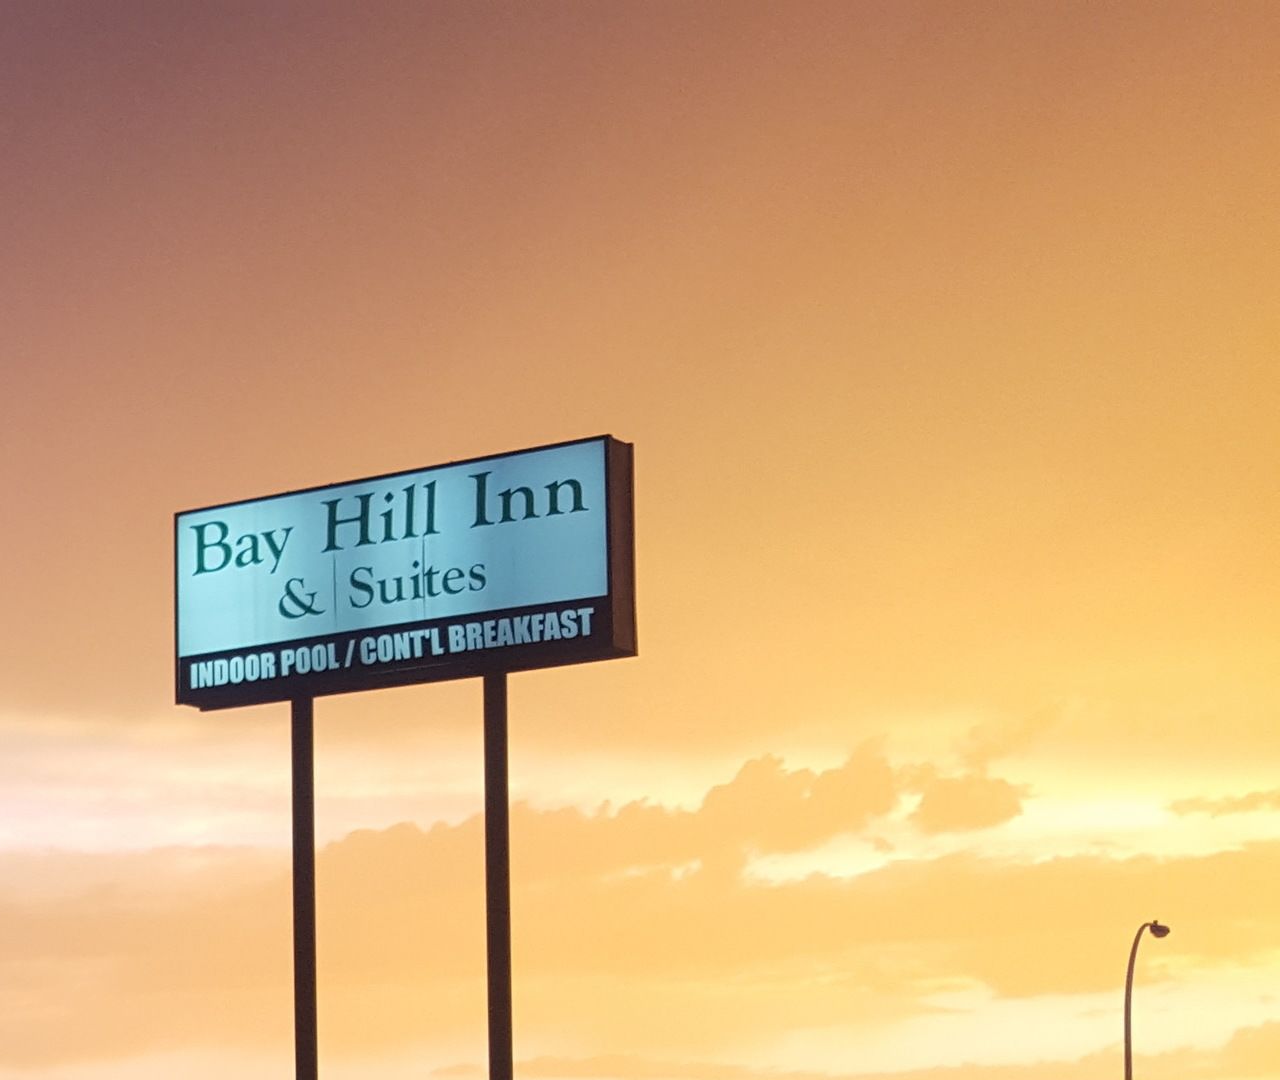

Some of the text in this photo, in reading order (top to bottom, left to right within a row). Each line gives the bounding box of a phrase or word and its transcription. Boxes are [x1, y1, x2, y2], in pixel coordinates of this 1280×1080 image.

[190, 470, 590, 576] Bay Hill Inn
[278, 559, 487, 620] & Suites
[190, 607, 595, 690] INDOOR POOL / CONT'L BREAKFAST
